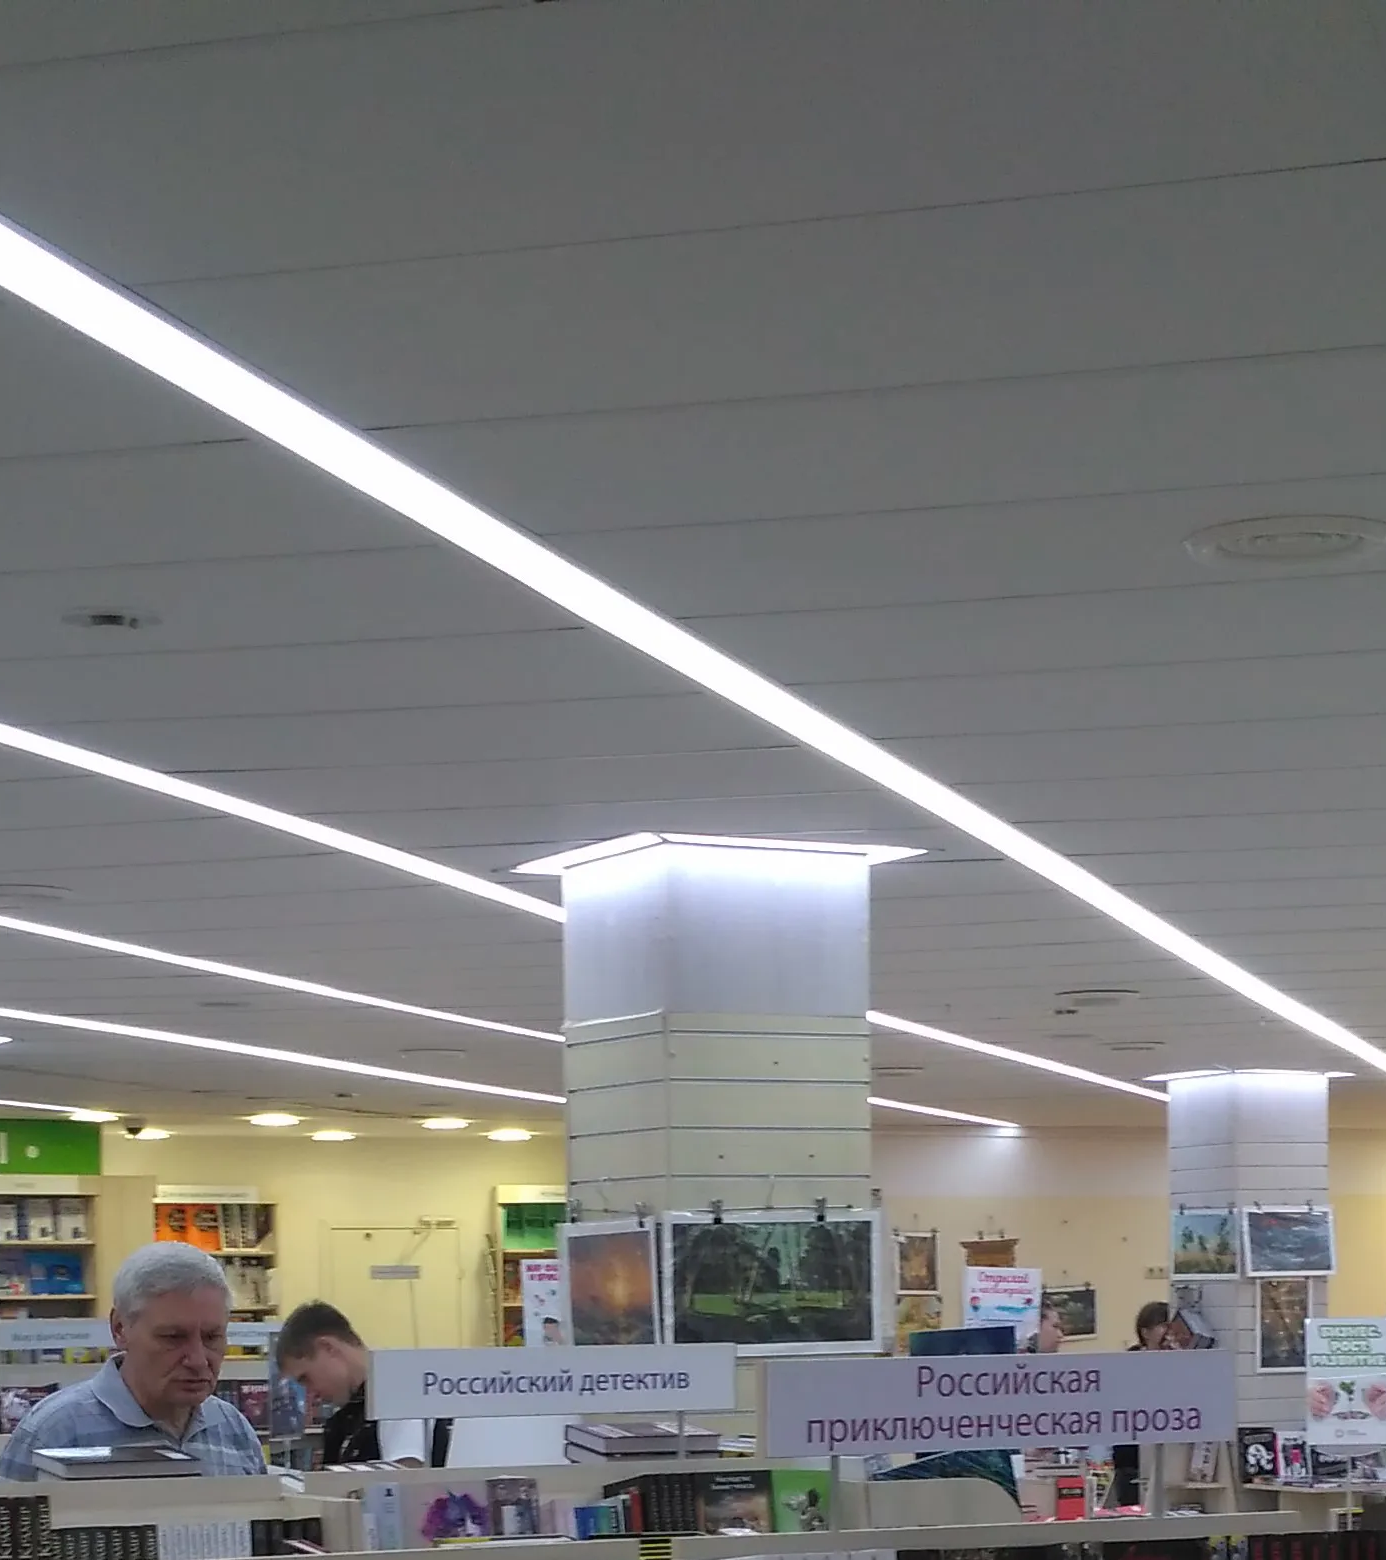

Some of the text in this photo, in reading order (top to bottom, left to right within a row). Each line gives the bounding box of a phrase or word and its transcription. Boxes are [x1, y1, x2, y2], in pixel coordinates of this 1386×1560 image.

[422, 1368, 691, 1397] Российский детектив
[916, 1365, 1102, 1400] Российская
[806, 1403, 1203, 1452] приключенческая проза
